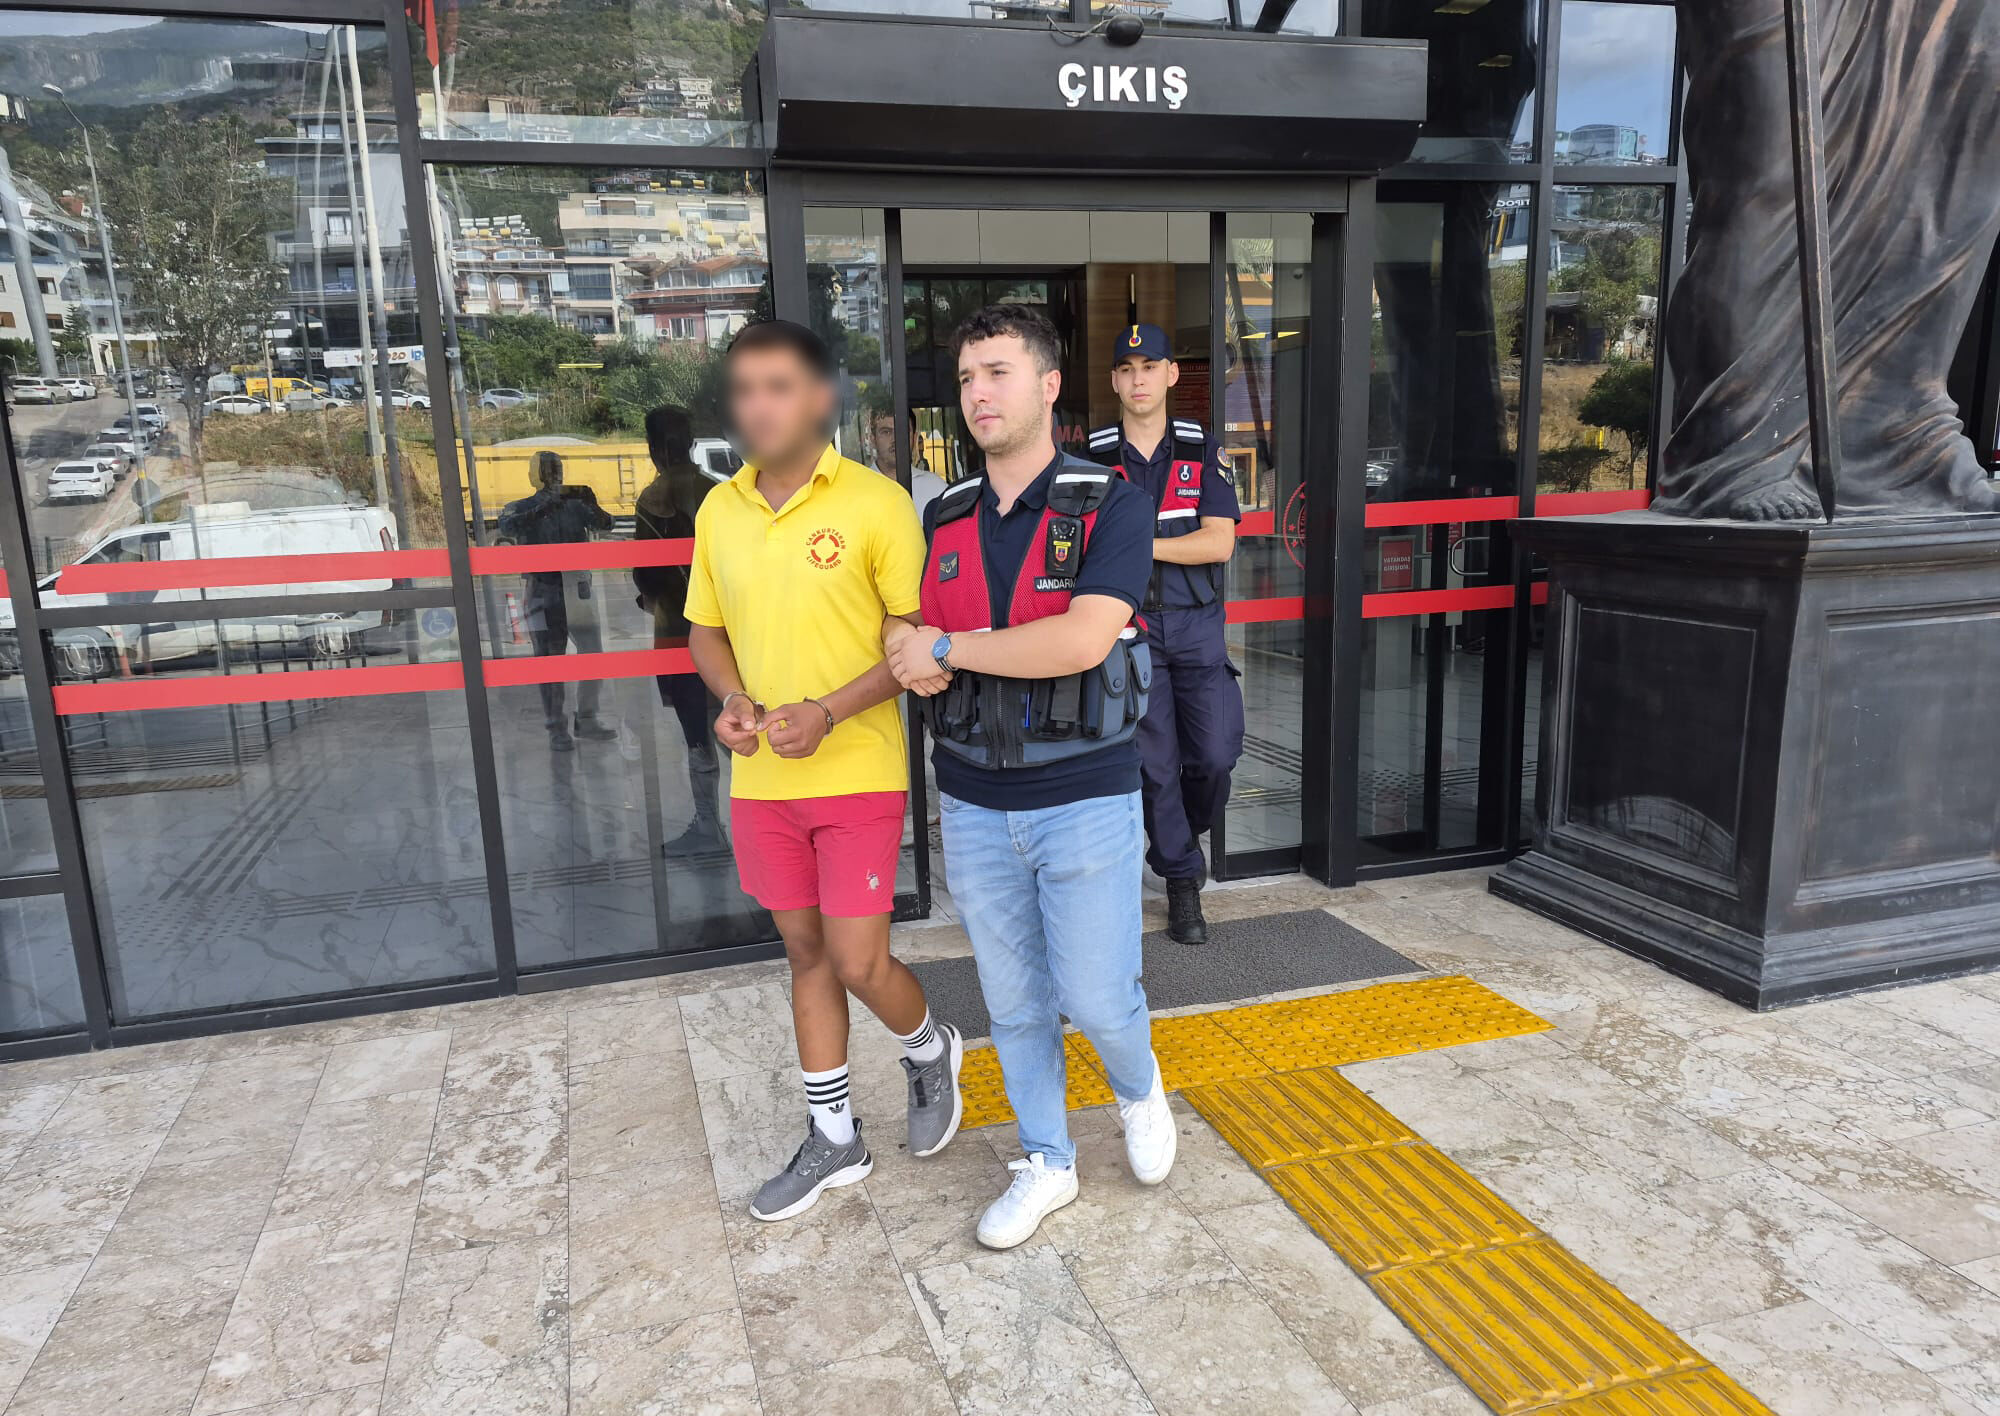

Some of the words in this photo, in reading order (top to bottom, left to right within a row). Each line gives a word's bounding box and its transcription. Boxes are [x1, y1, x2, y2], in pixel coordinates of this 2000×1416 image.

[1058, 62, 1189, 110] ÇIKIŞ
[806, 527, 846, 549] CANKURTARAN
[806, 555, 842, 570] LIFEGUARD
[1036, 578, 1076, 590] JANDARM
